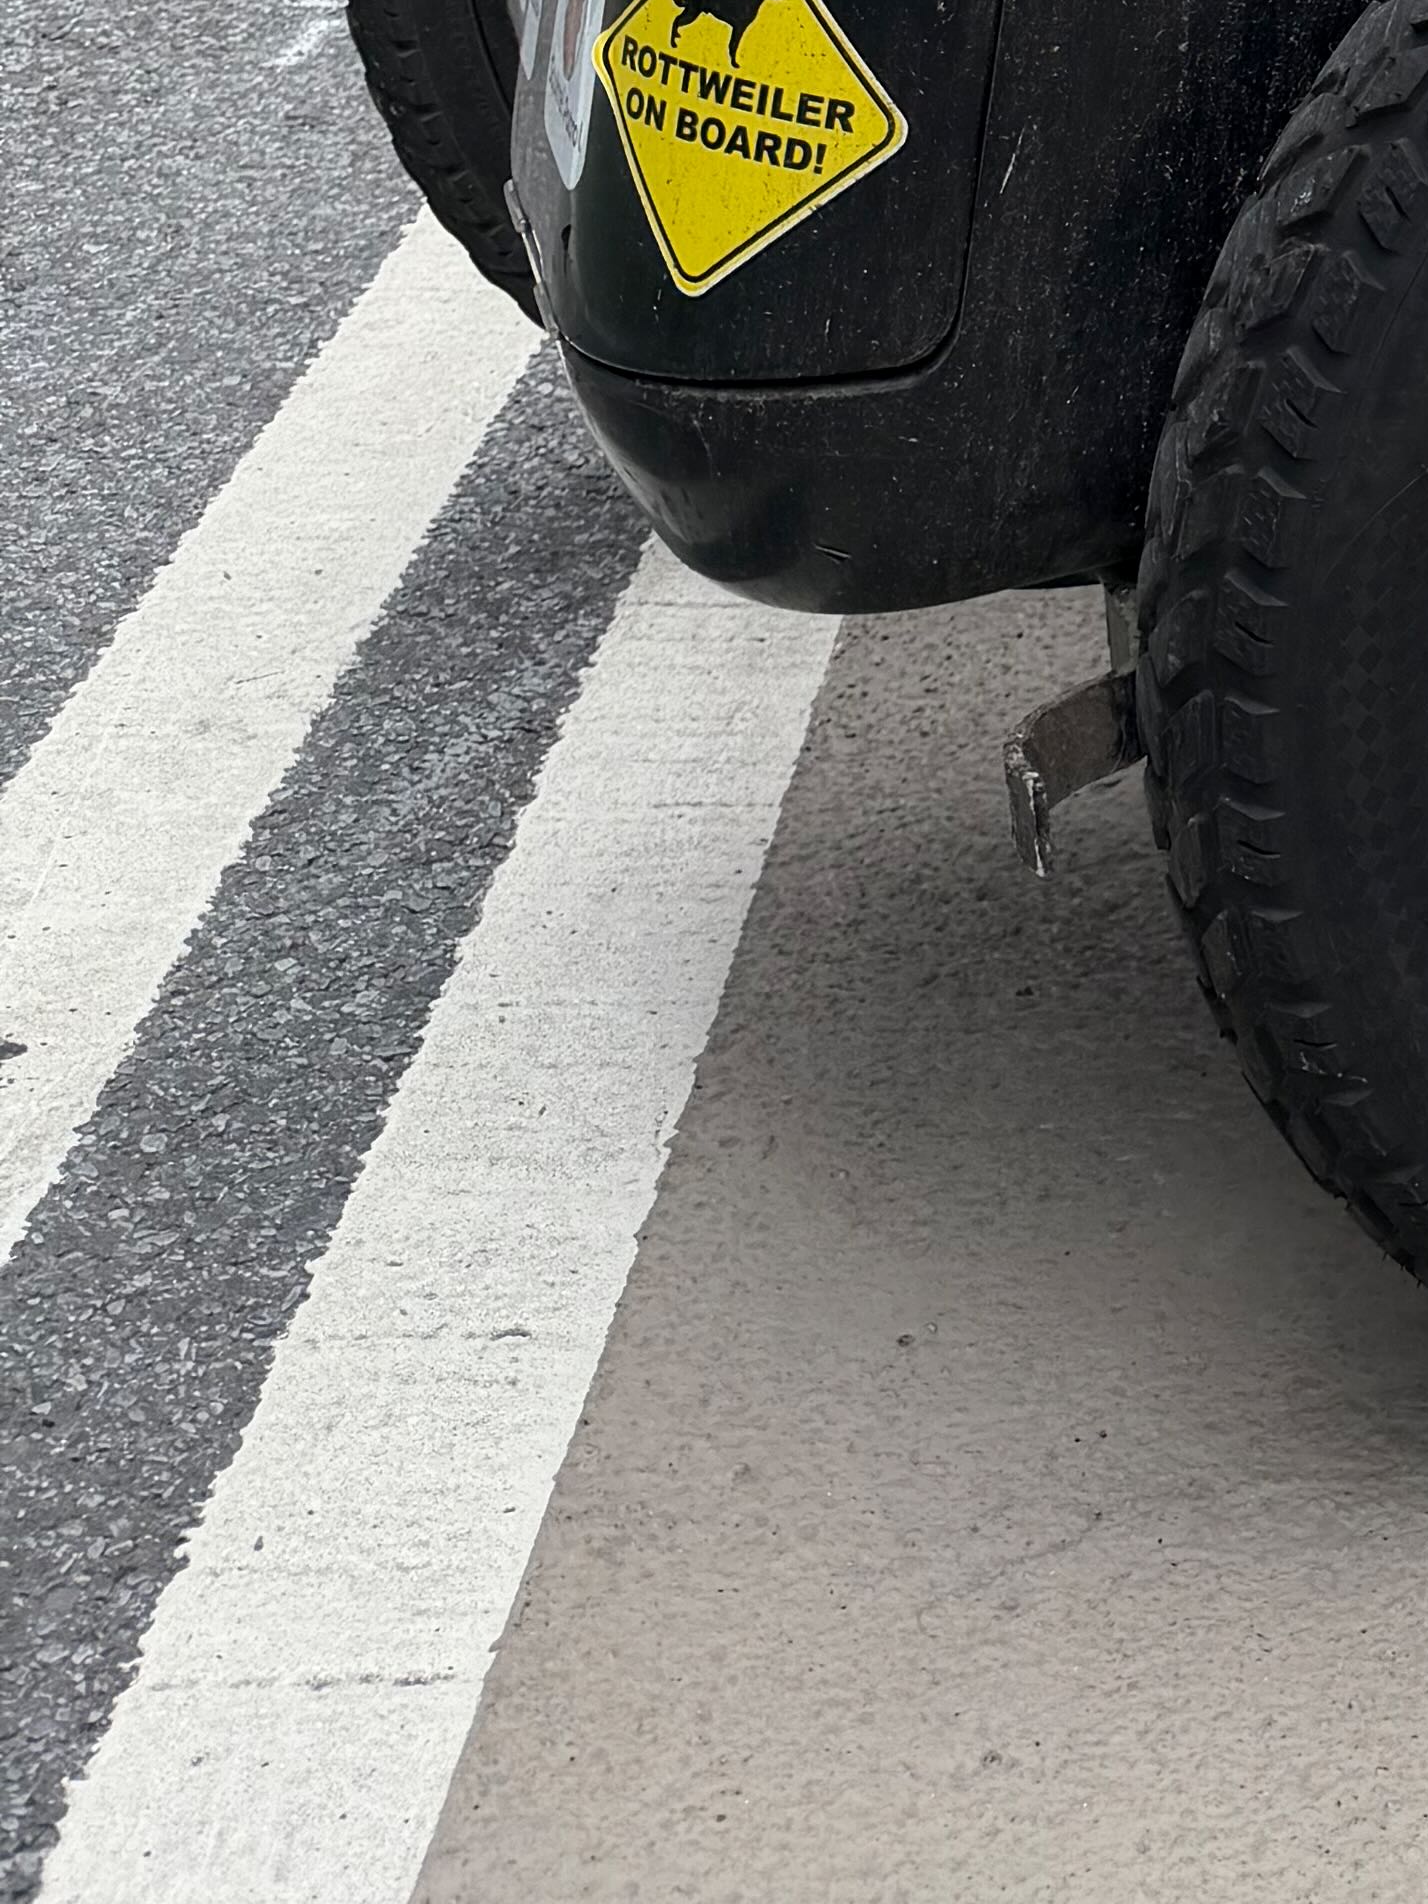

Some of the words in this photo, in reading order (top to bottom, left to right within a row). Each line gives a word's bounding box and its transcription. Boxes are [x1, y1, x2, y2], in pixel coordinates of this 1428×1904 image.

[622, 35, 855, 134] ROTTWEILER
[626, 87, 667, 132] ON
[676, 108, 827, 175] BOARD!
